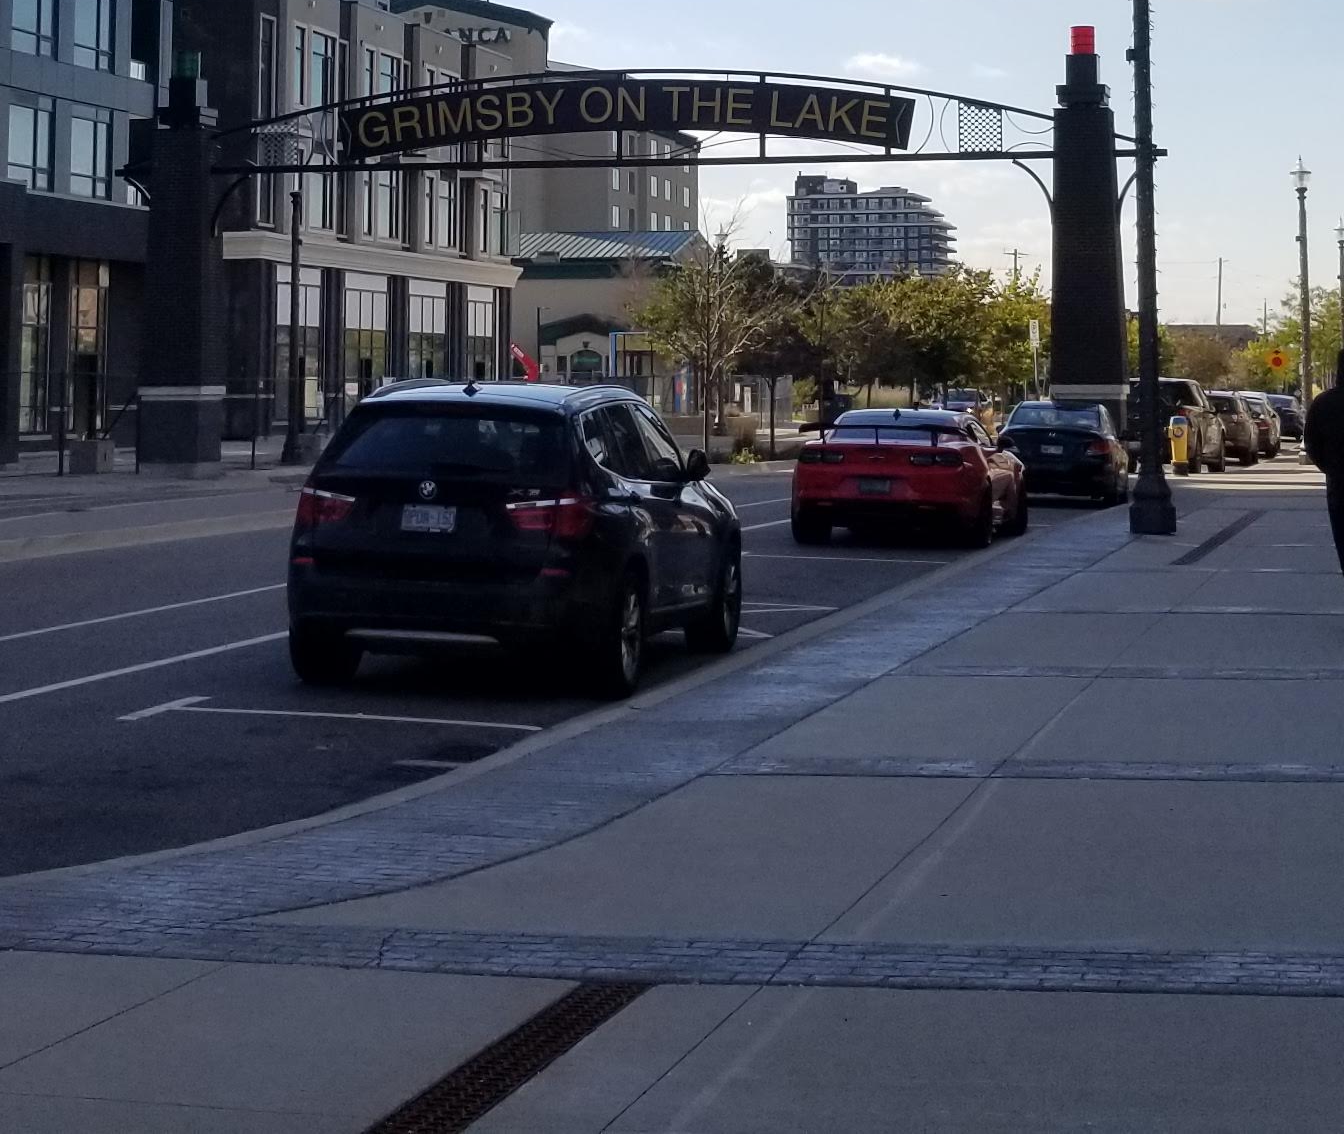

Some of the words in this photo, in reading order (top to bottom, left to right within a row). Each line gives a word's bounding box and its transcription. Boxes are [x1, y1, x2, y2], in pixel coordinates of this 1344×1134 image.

[357, 88, 566, 149] GRIMSBY
[579, 85, 646, 124] ON
[662, 87, 754, 125] THE
[770, 90, 892, 140] LAKE
